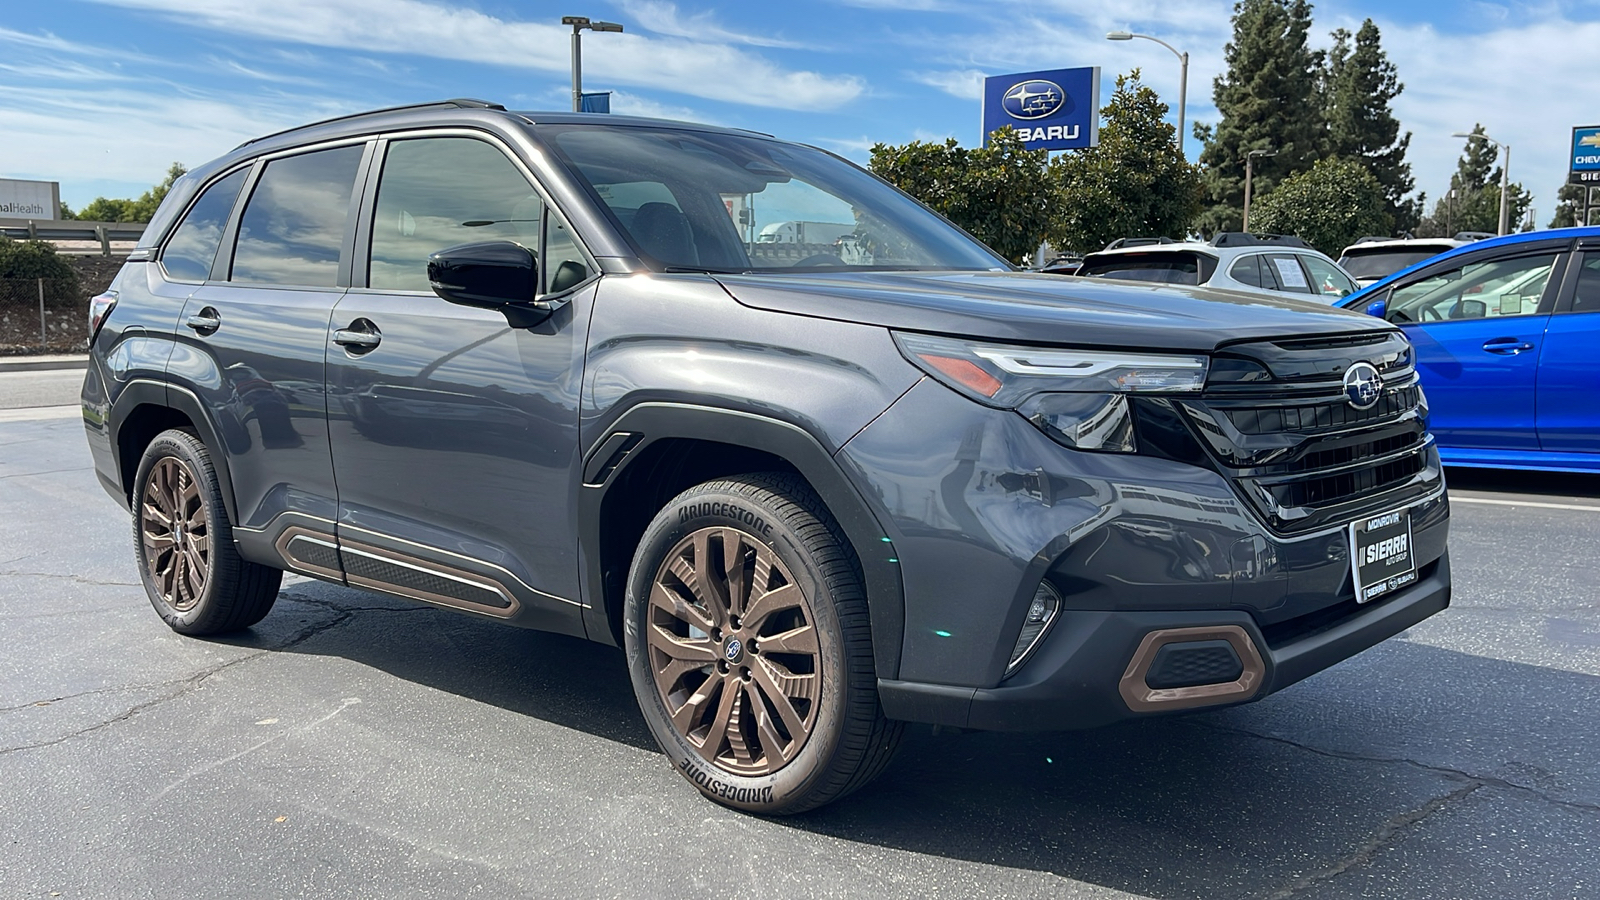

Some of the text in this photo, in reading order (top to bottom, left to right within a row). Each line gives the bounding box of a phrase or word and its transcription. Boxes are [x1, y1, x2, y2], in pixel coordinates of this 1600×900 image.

[1012, 125, 1080, 142] BARU
[678, 502, 774, 538] BRIDGESTONE
[1366, 533, 1408, 564] SIERRA
[678, 757, 775, 805] BRIDGESTONE
